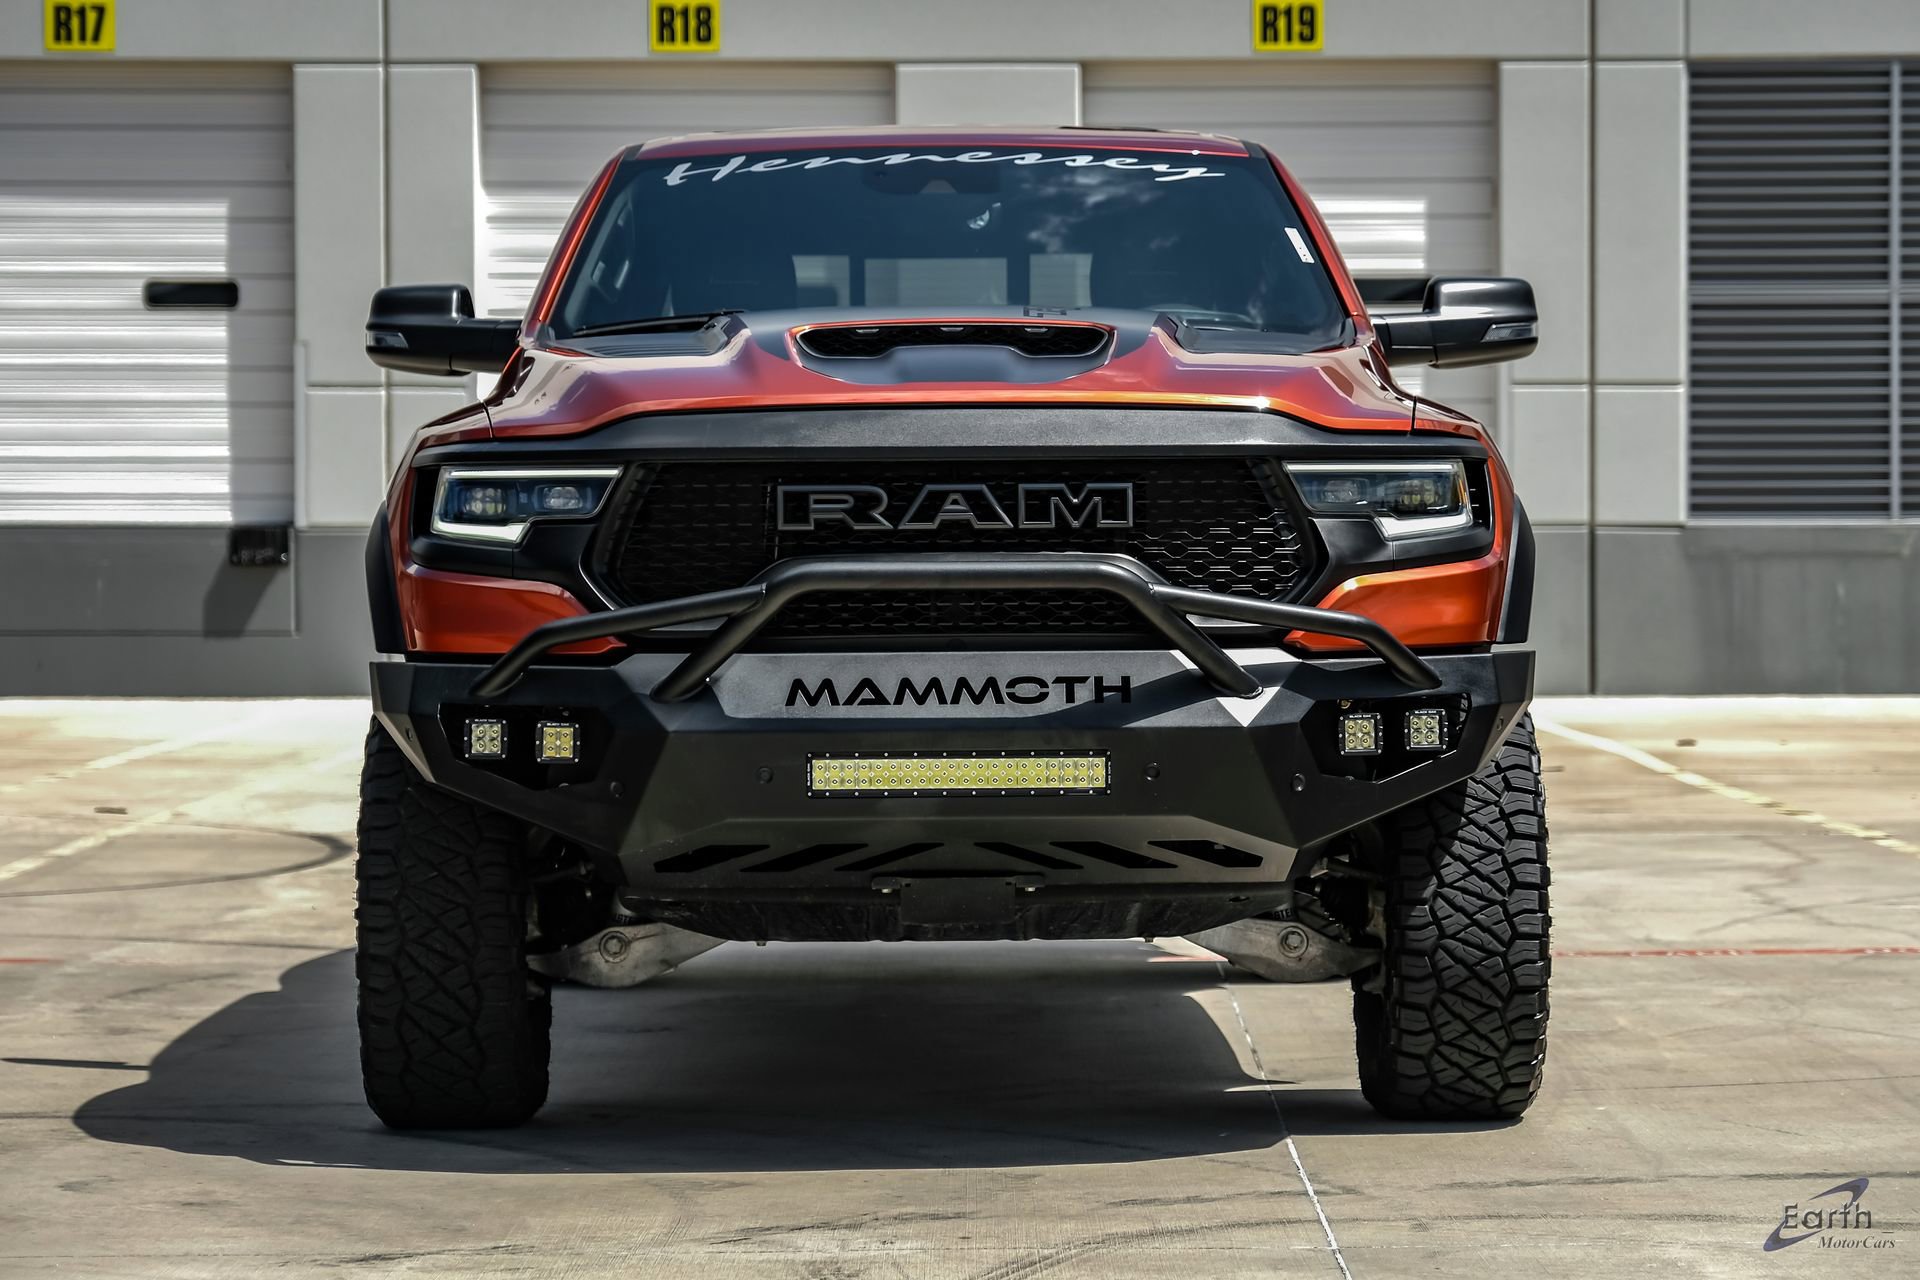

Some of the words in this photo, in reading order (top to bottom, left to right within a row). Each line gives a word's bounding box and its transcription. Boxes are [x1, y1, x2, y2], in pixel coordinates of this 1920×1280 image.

[53, 5, 106, 44] R17
[657, 5, 713, 44] R18
[1261, 4, 1316, 44] R19
[663, 148, 1225, 187] Hennessey
[777, 483, 1134, 530] RAM
[785, 675, 1132, 707] MAMMOTH
